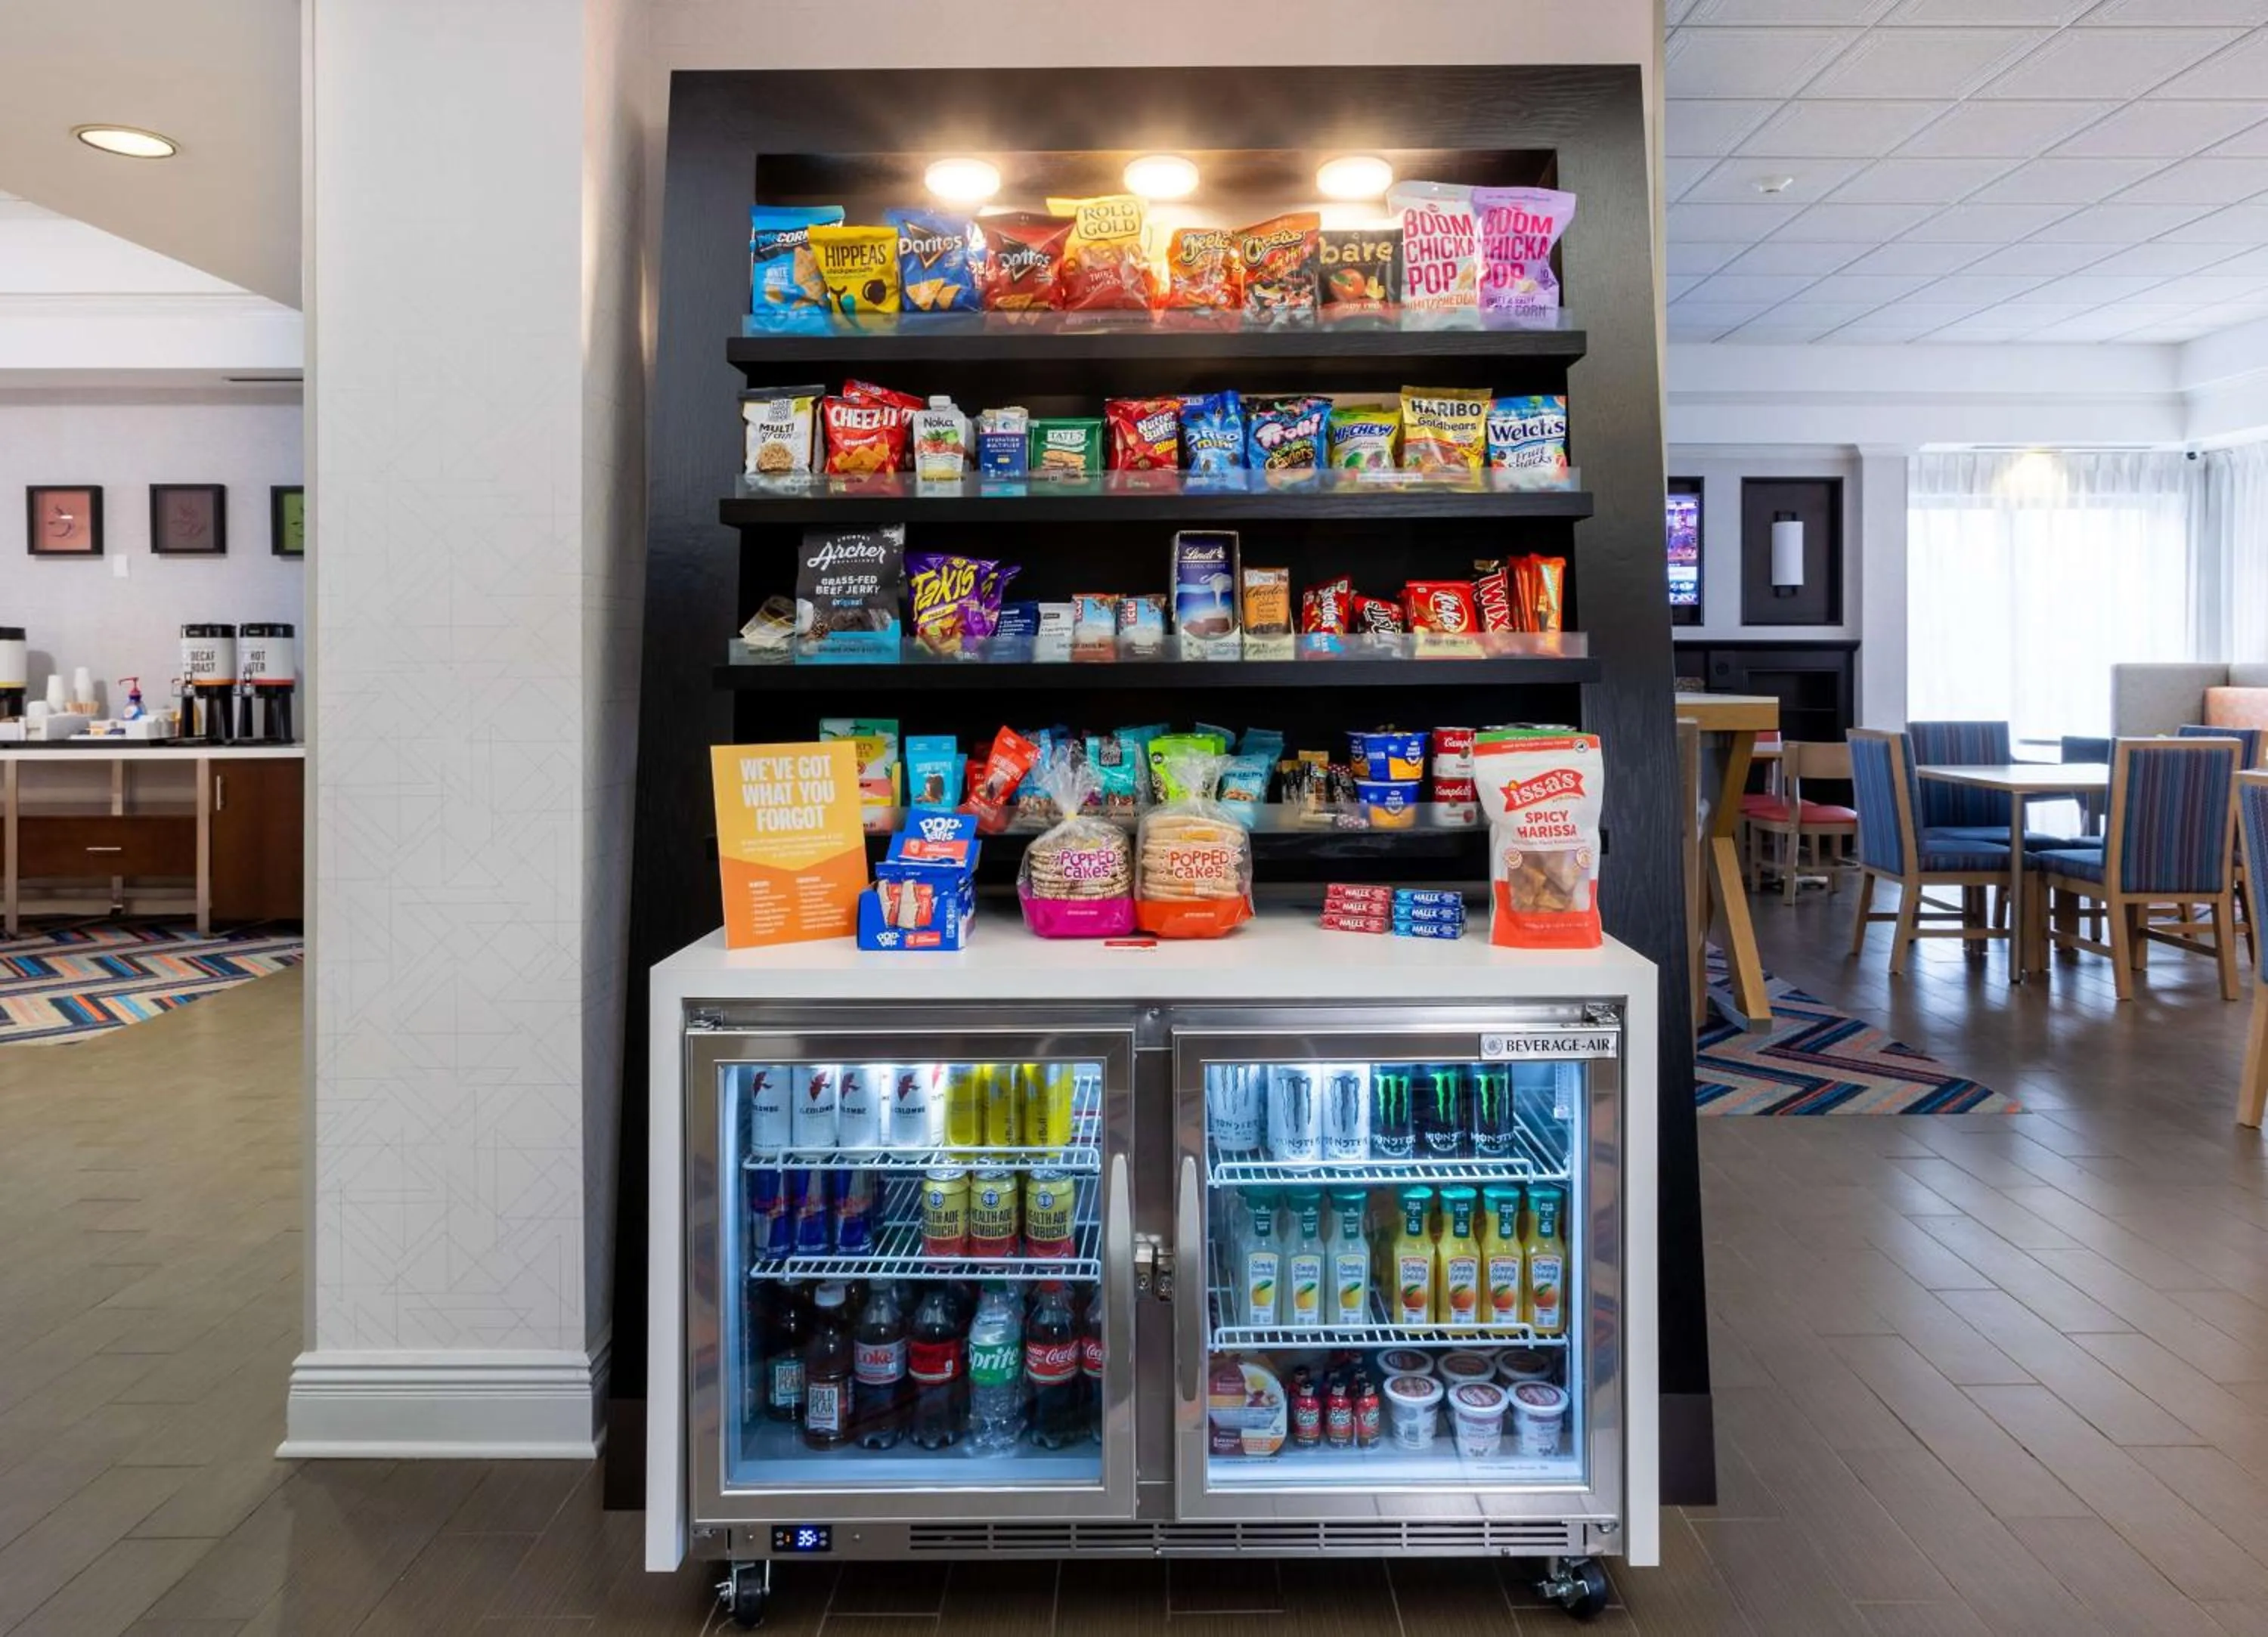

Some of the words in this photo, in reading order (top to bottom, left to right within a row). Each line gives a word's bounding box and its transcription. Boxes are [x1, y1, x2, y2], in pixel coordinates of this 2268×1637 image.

[1083, 203, 1134, 221] ROLD
[1483, 207, 1554, 235] BOOM
[1084, 219, 1136, 237] GOLD
[1404, 208, 1473, 240] BOOM
[899, 235, 962, 255] Doritos
[1318, 237, 1393, 265] bare
[1405, 237, 1474, 264] CHICKA
[1483, 236, 1550, 261] CHICKA
[825, 244, 886, 267] HIPPEAS
[999, 249, 1050, 268] Doritos
[1408, 261, 1458, 296] POP
[1514, 305, 1547, 317] CORN
[1411, 400, 1483, 417] HARIBO
[758, 423, 794, 433] MULTI
[924, 417, 954, 429] Noka
[1137, 411, 1175, 432] Nutter
[1256, 413, 1321, 448] Trolli
[1418, 417, 1476, 431] Goldbears
[1491, 419, 1564, 442] Welch's
[1333, 423, 1395, 444] HI-CHEW
[807, 541, 886, 571] Archer
[1182, 546, 1219, 561] Lindt
[821, 575, 878, 586] GRASS-FED
[816, 585, 843, 595] BEEF
[845, 585, 881, 595] JERKY
[911, 565, 979, 622] Takis
[1317, 583, 1337, 627] Skittles
[1478, 568, 1513, 634] TWIX
[190, 651, 215, 661] DECAF
[250, 651, 266, 661] HOT
[740, 757, 795, 781] WE'VE
[798, 755, 832, 778] GOT
[742, 783, 795, 807] WHAT
[798, 781, 835, 805] YOU
[756, 805, 826, 832] FORGOT
[1525, 810, 1569, 824] SPICY
[1517, 825, 1576, 839] HARISSA
[1060, 849, 1117, 867] POPPED
[1170, 849, 1230, 867] POPPED
[1064, 865, 1111, 879] cakes
[1174, 867, 1223, 879] cakes
[1413, 893, 1439, 903] HALLS
[1411, 909, 1437, 919] HALLS
[1411, 925, 1438, 935] HALLS
[1506, 1038, 1610, 1053] BEVERAGE-AIR
[798, 1530, 814, 1547] 35
